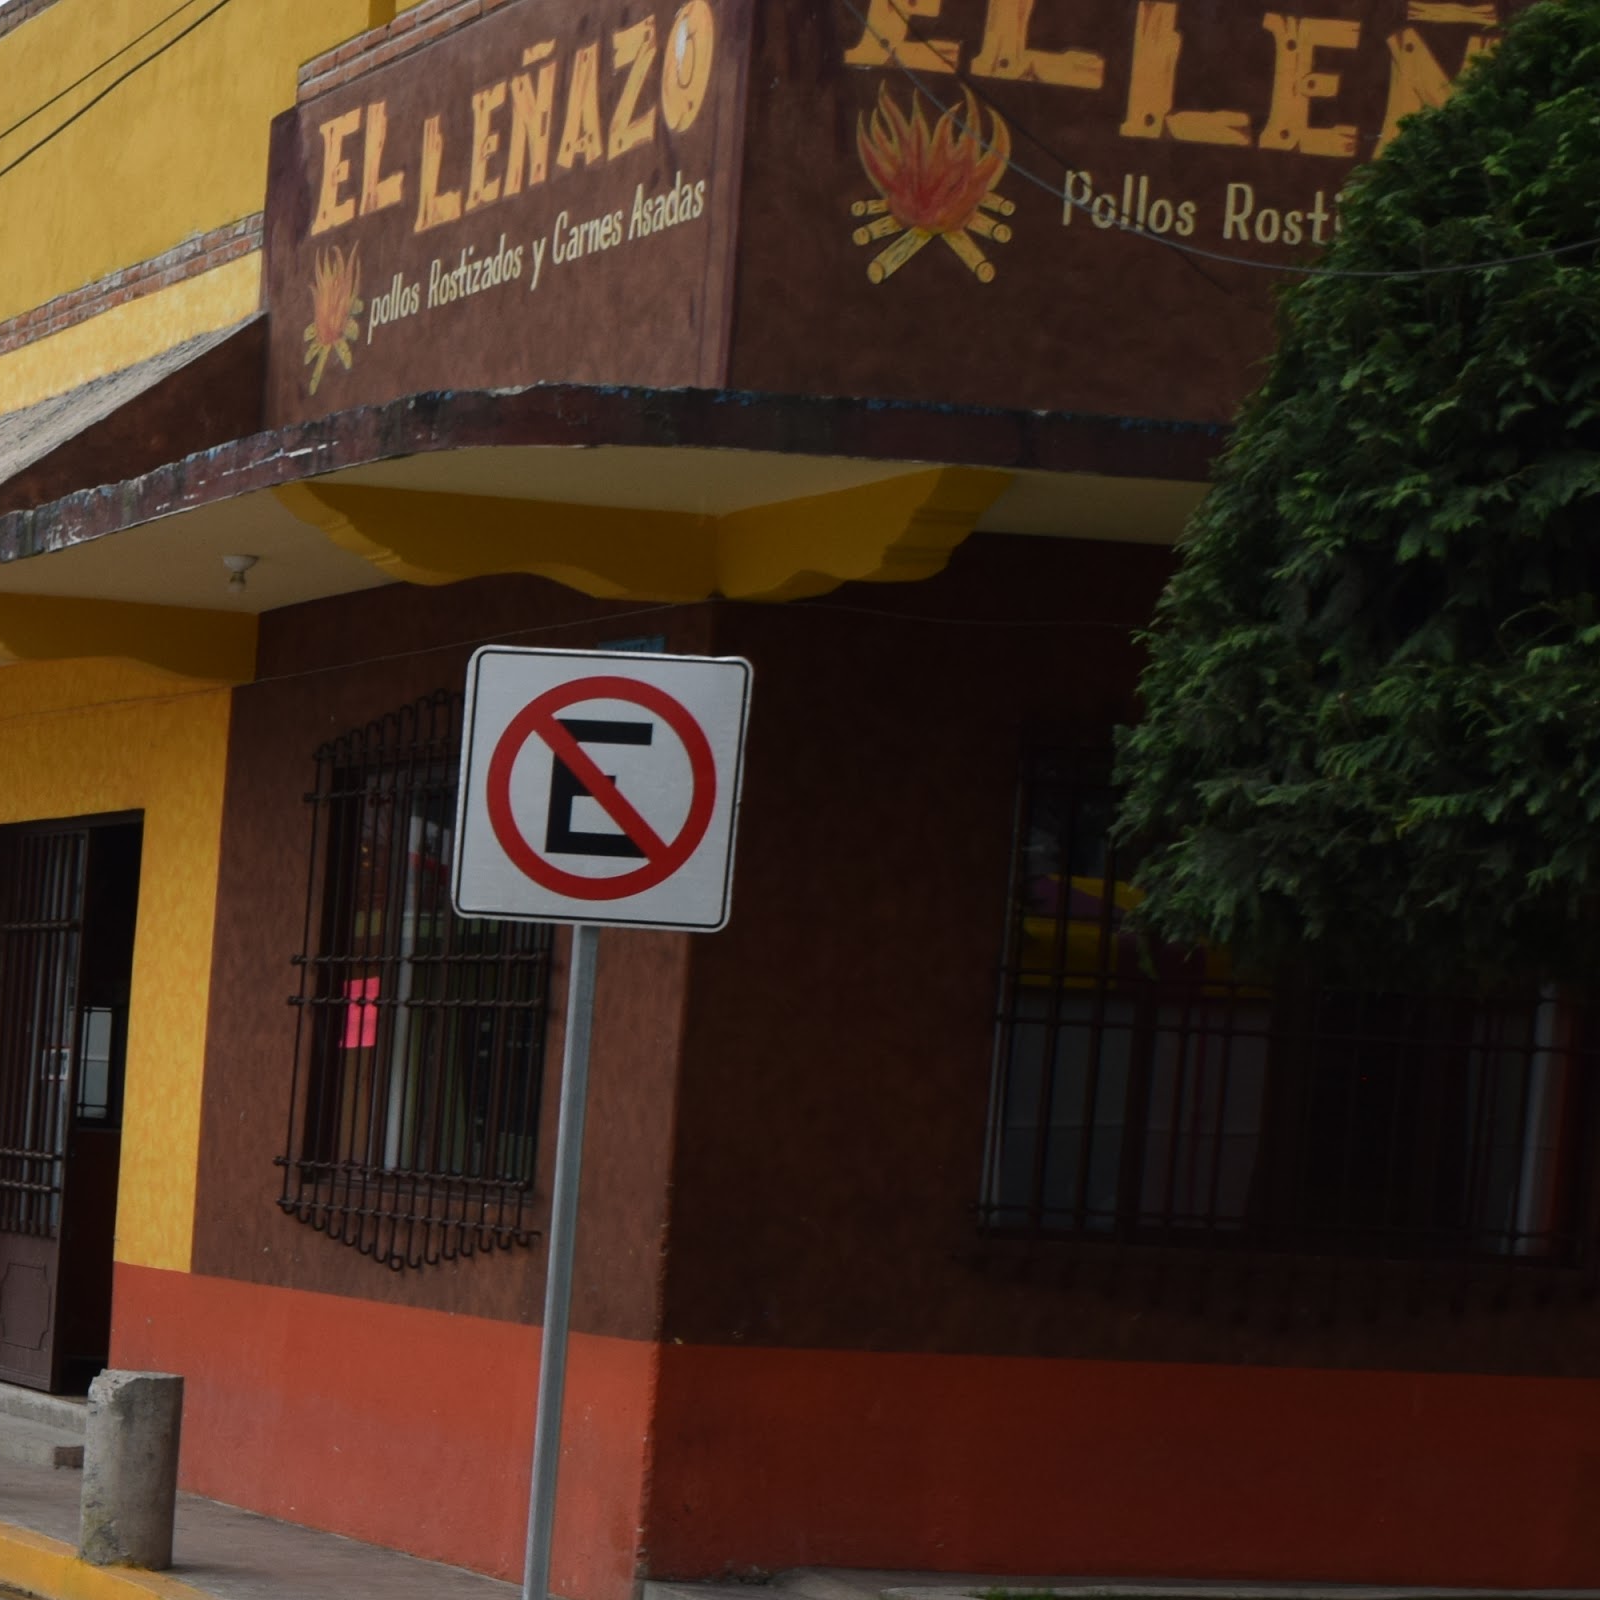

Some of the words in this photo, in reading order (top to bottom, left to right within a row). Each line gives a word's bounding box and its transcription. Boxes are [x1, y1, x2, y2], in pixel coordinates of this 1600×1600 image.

[310, 101, 405, 237] EL
[413, 0, 715, 234] LEÑAZO
[427, 233, 525, 310] Rostizados
[532, 235, 547, 291] y
[552, 208, 624, 266] Carnes
[627, 170, 707, 241] Asadas
[1062, 169, 1197, 237] Pollos
